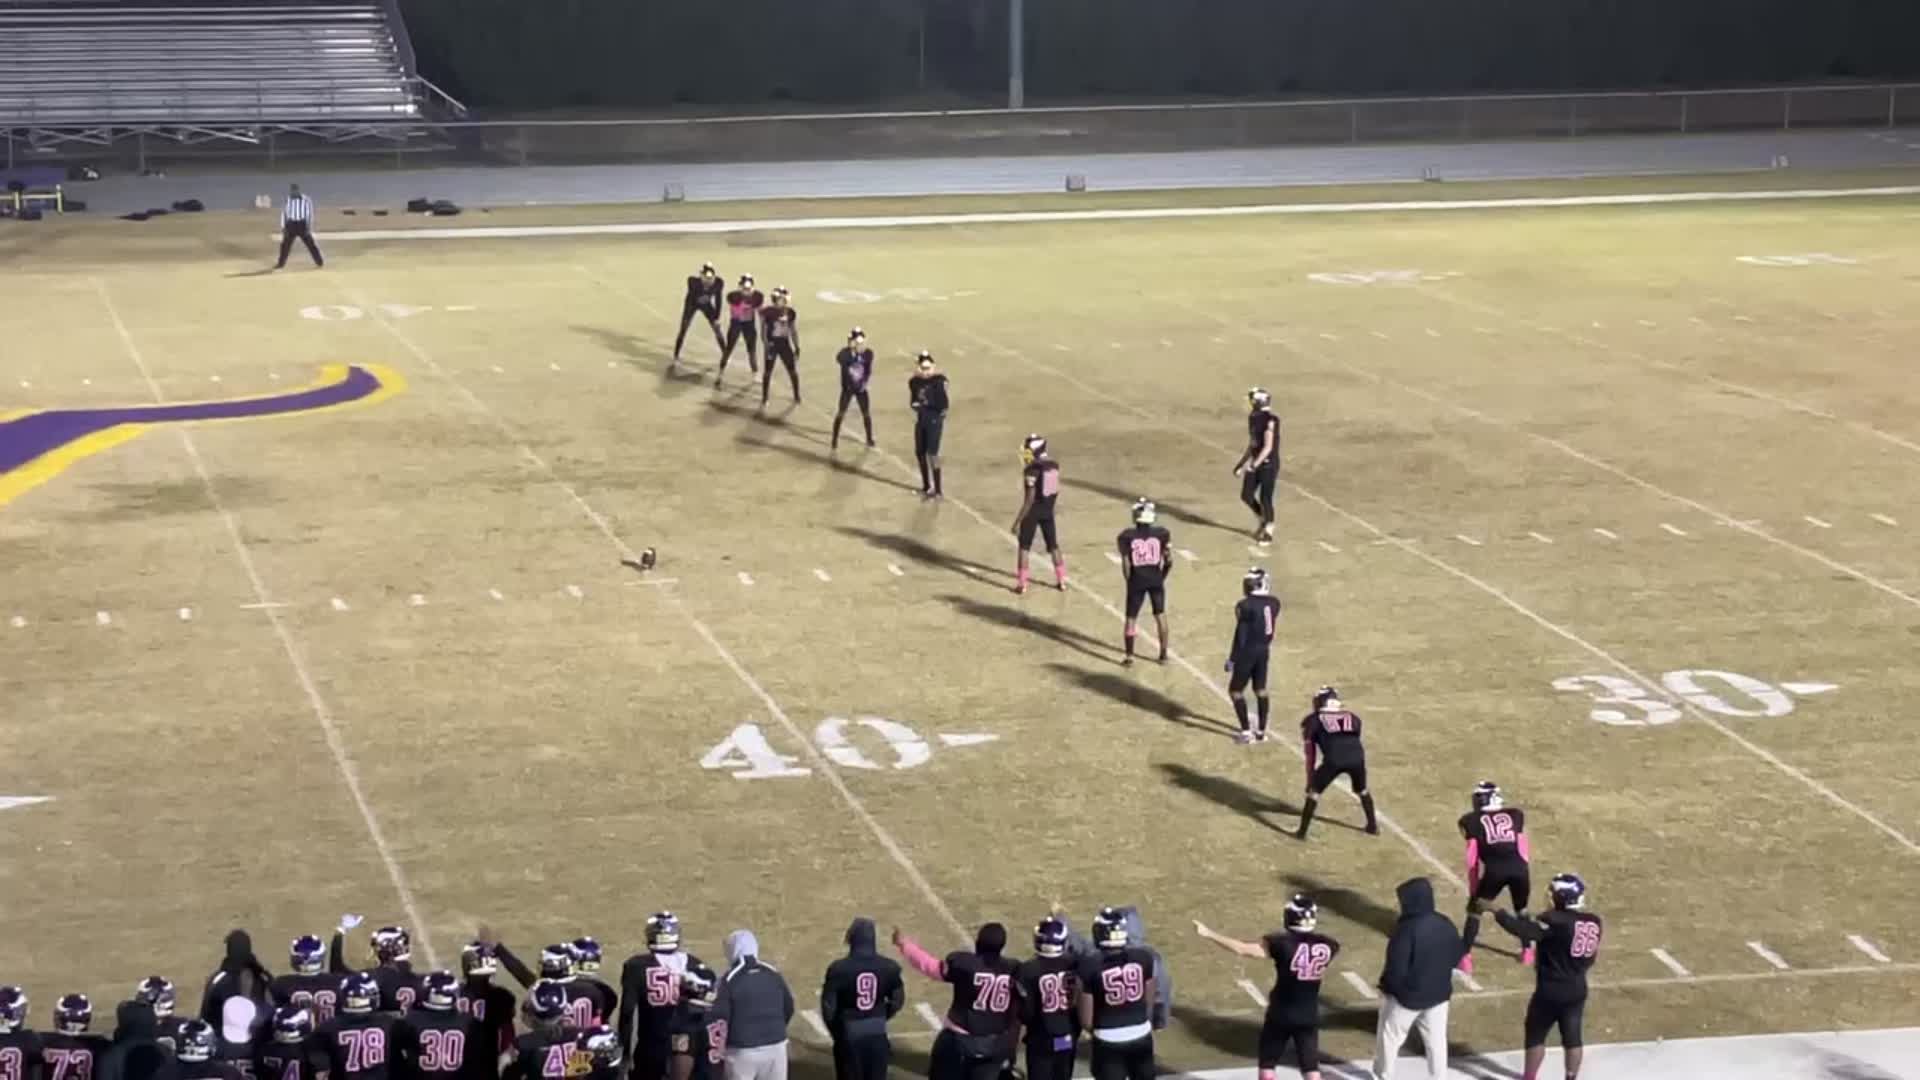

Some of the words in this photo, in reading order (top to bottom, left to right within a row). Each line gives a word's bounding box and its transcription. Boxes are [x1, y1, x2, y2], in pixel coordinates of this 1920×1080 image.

[1131, 537, 1161, 566] 20
[1551, 669, 1794, 725] 30
[700, 716, 931, 778] 40
[1480, 814, 1516, 844] 12
[1290, 943, 1331, 980] 42
[856, 972, 878, 1010] 9
[972, 972, 1011, 1012] 76
[1102, 963, 1143, 1006] 59
[338, 1027, 385, 1072] 78
[419, 1029, 465, 1071] 30
